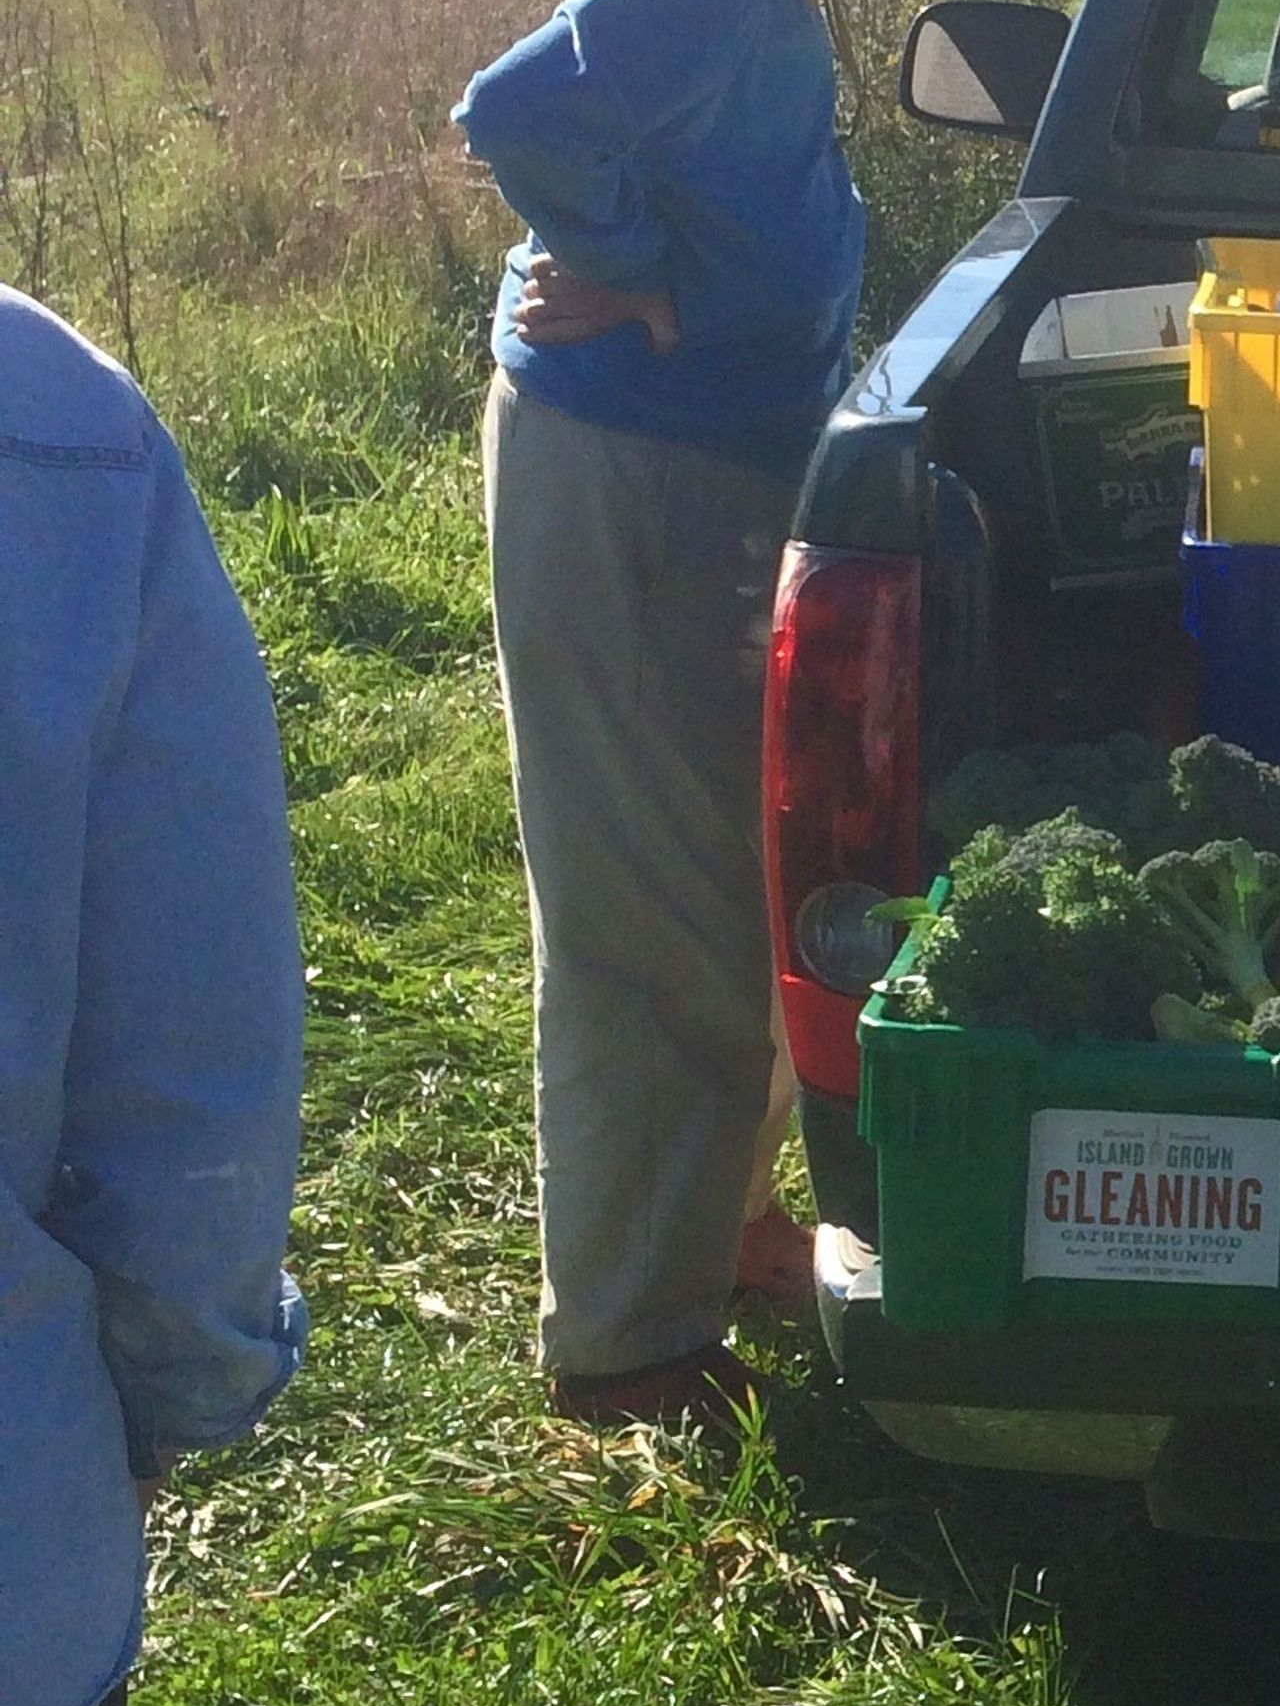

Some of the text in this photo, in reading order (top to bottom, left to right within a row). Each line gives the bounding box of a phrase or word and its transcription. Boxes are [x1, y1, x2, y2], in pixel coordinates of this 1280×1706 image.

[1078, 1140, 1234, 1171] ISLAND GROWN
[1044, 1169, 1263, 1231] GLEANING
[1060, 1229, 1242, 1249] GATHERING FOOD
[1107, 1247, 1235, 1264] COMMUNITY
